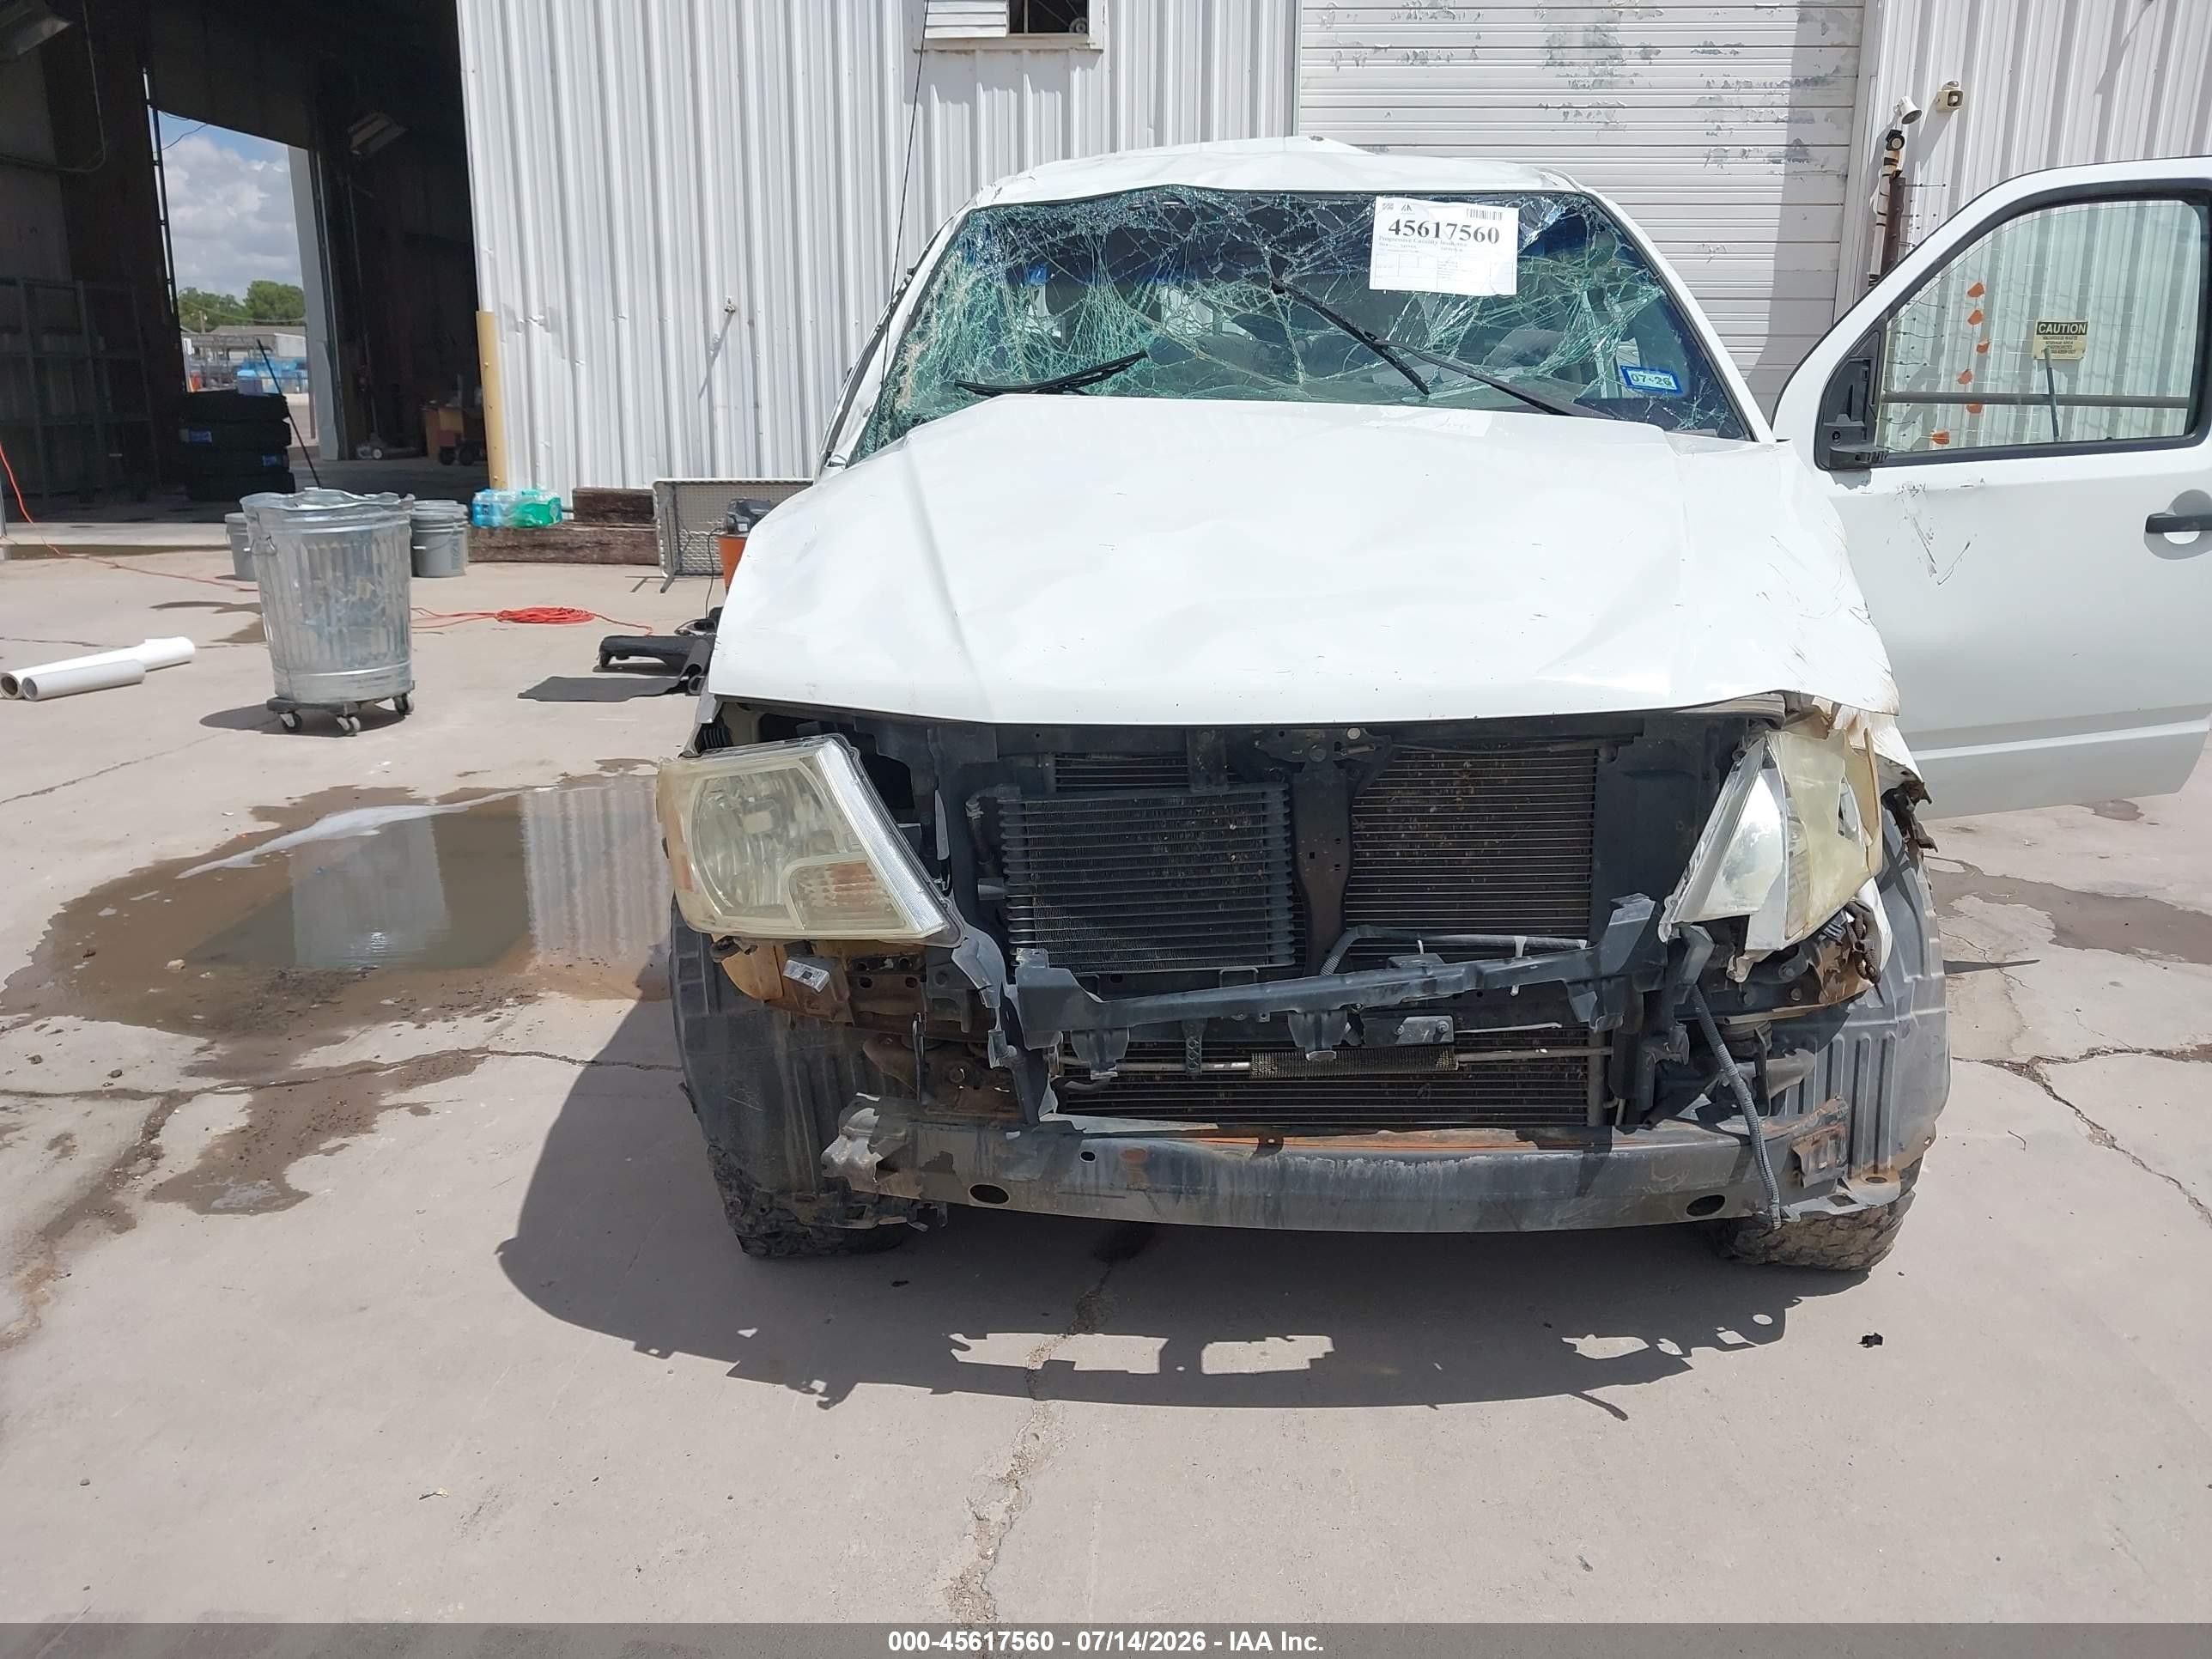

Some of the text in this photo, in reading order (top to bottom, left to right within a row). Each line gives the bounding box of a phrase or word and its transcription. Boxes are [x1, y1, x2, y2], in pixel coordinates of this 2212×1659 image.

[1388, 218, 1500, 245] 45617560
[2038, 323, 2087, 334] CAUTION
[1631, 373, 1673, 386] 07-26
